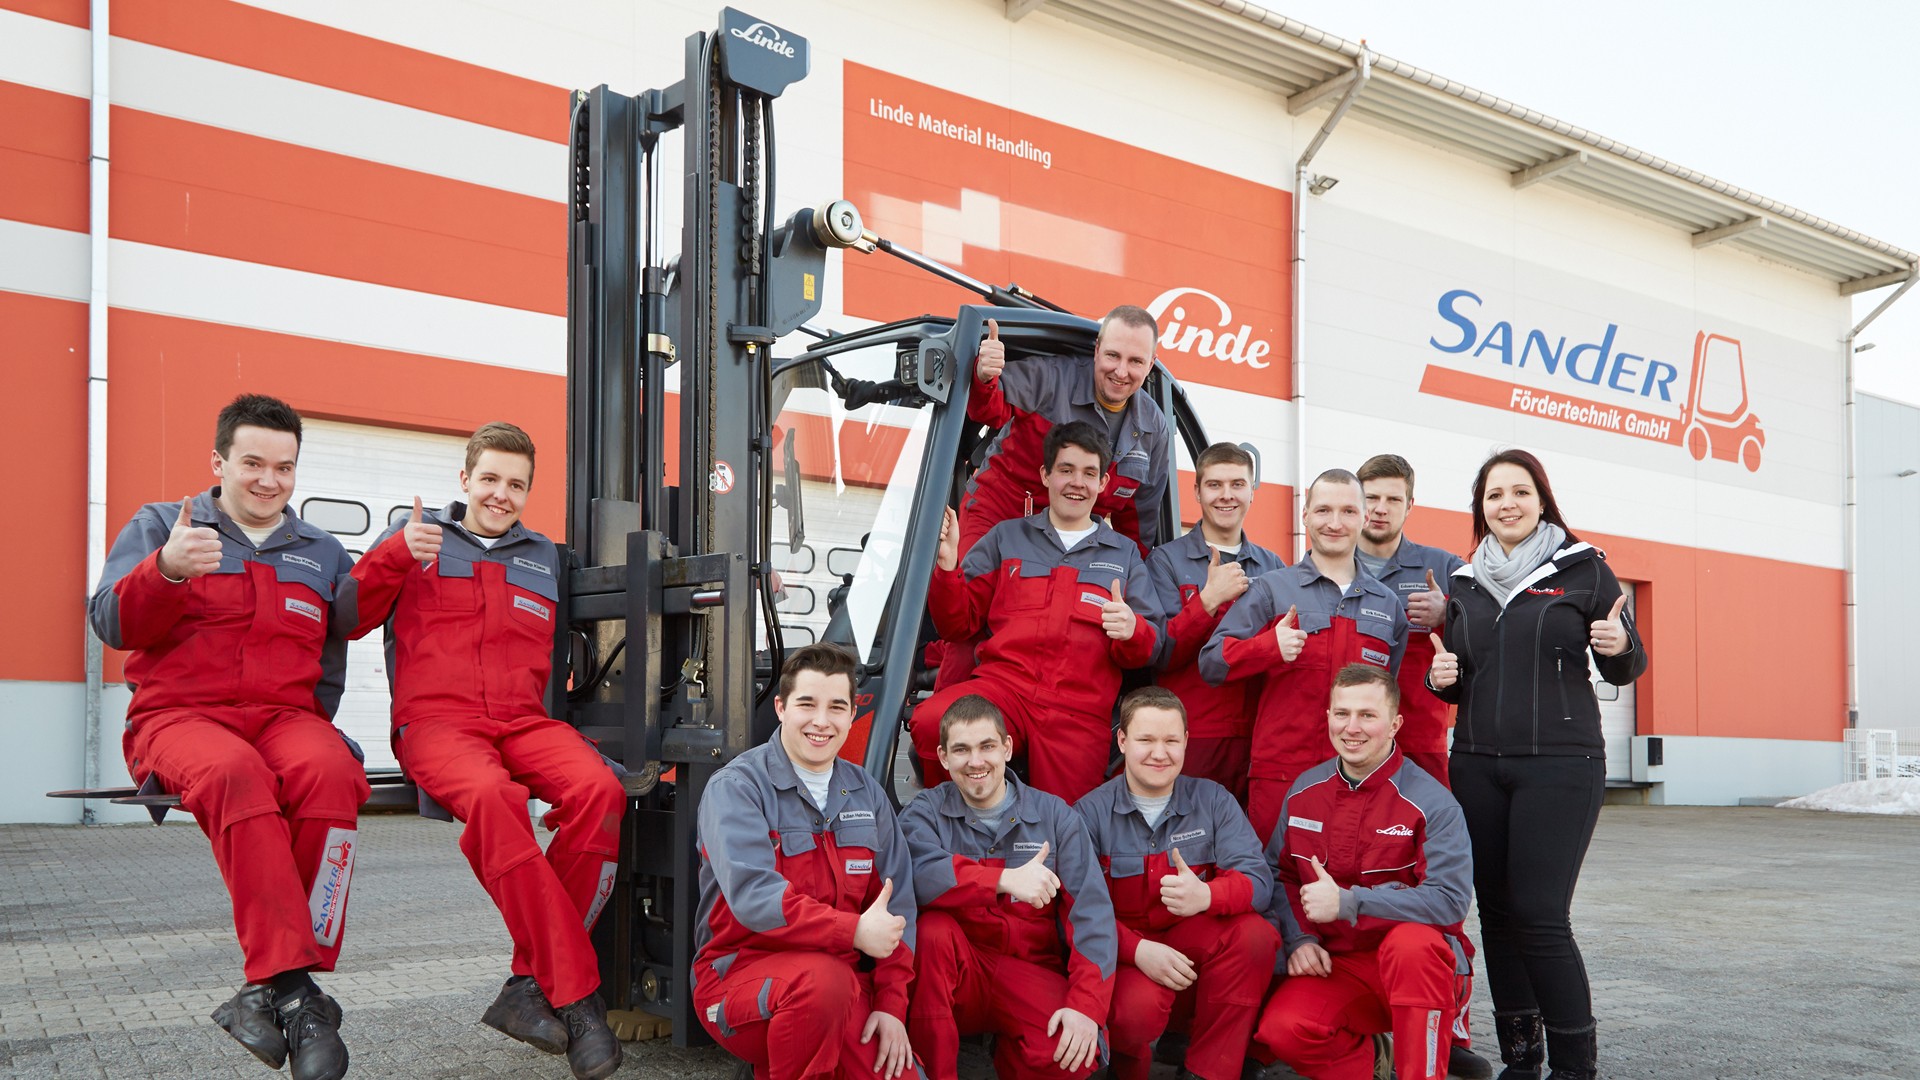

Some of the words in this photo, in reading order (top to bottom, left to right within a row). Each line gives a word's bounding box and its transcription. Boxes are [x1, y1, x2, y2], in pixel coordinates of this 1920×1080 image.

[731, 23, 794, 58] Linde
[870, 98, 914, 126] Linde
[918, 112, 982, 145] Material
[986, 131, 1051, 169] Handling
[1510, 388, 1621, 430] Fördertechnik
[1625, 413, 1671, 440] GmbH
[1376, 824, 1413, 836] Linde
